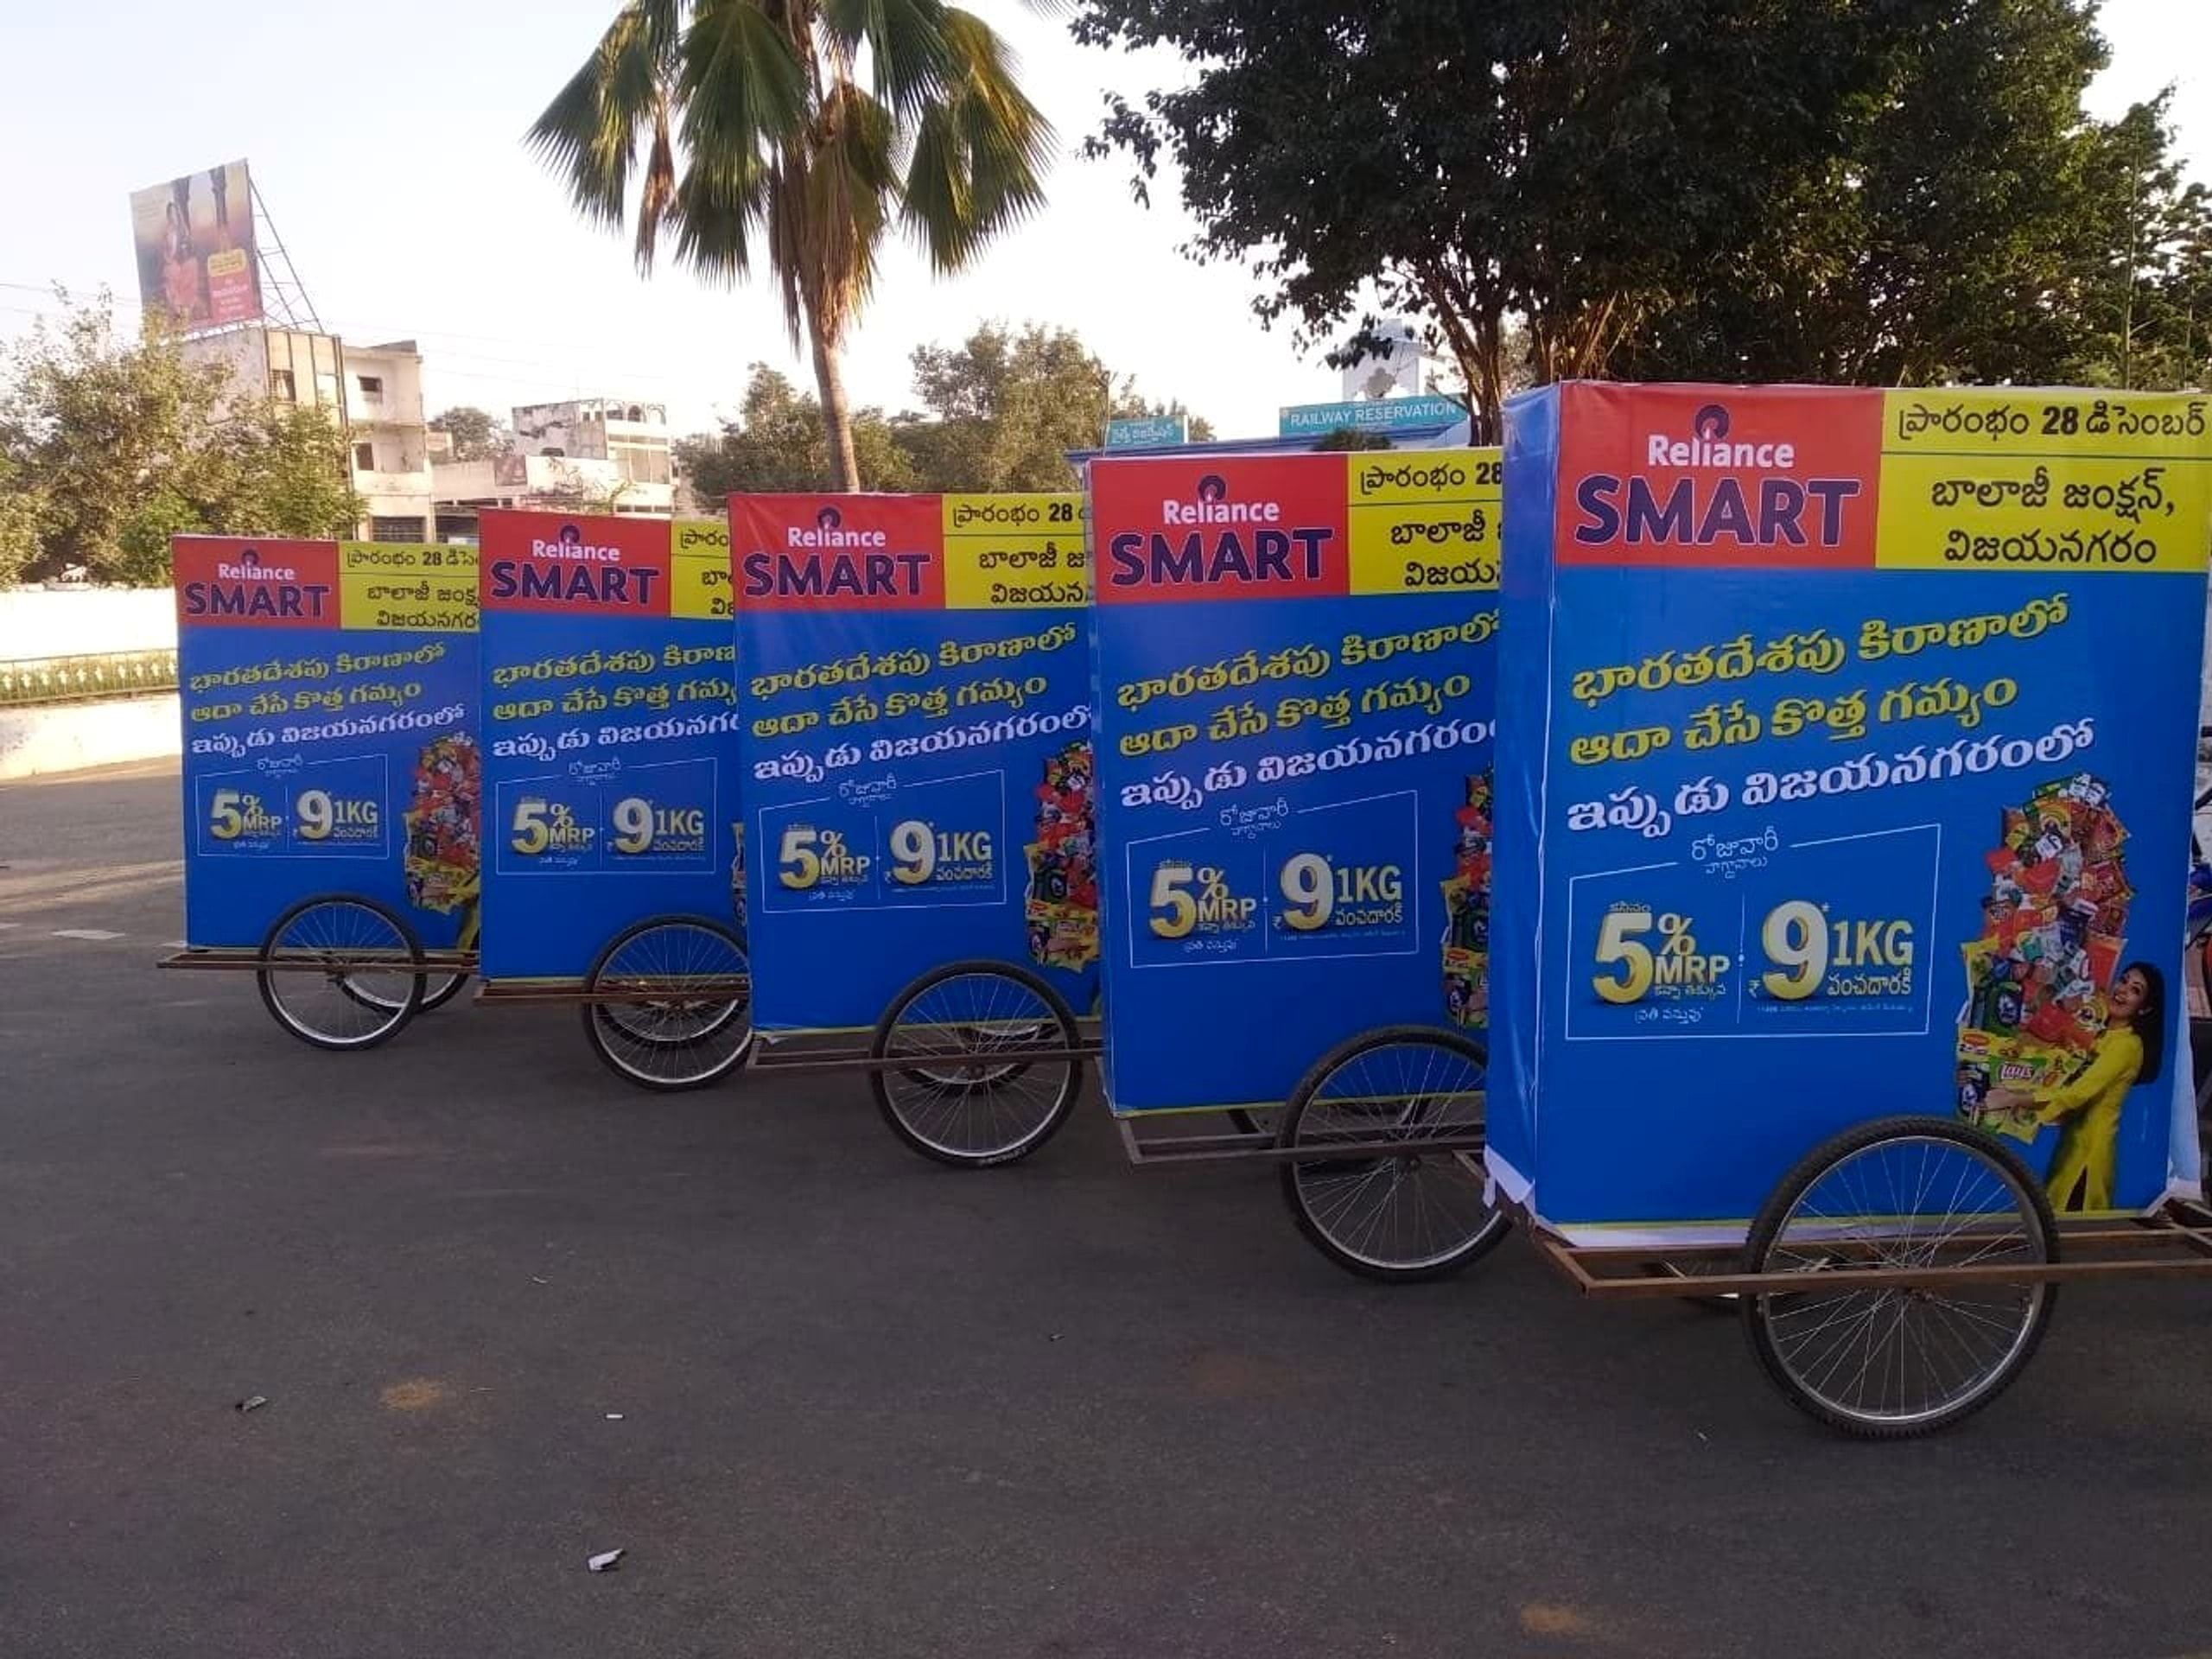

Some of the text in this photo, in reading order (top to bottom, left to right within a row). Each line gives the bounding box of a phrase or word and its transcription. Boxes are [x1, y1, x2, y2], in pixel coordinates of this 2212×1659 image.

[1291, 401, 1457, 427] RAILWAY RESERVATION
[1898, 400, 2208, 442] ప్రారంభం 28 డిసెంబర్
[1648, 431, 1795, 469] Reliance
[1361, 466, 1465, 495] ప్రారంభం
[1931, 466, 2176, 524] బాలాజీ జంక్షన్,
[953, 503, 1073, 528] ప్రారంభం 28
[1163, 496, 1280, 524] Reliance
[1390, 509, 1485, 545] బాలాజీ
[1573, 474, 1861, 548] SMART
[532, 537, 621, 562] Reliance
[787, 524, 887, 548] Reliance
[1943, 529, 2158, 565] విజయనగరం
[219, 562, 296, 581] Reliance
[423, 551, 442, 566] 28
[978, 542, 1057, 569] బాలాజీ
[1109, 527, 1334, 587] SMART
[367, 580, 430, 601] బాలాజీ
[491, 561, 659, 604] SMART
[742, 552, 931, 597] SMART
[184, 582, 330, 617] SMART
[750, 622, 1077, 700] భారతదేశపు కిరాణాలో
[1570, 592, 2071, 709] భారతదేశపు కిరాణాలో
[190, 658, 330, 693] భారతదేశపు
[492, 650, 656, 689] భారతదేశపు
[1117, 644, 1332, 711] భారతదేశపు
[191, 702, 243, 721] ఆదా
[249, 694, 289, 716] చేసే
[493, 699, 554, 720] ఆదా
[563, 686, 608, 713] చేసే
[613, 683, 671, 709] కొత్త
[752, 675, 1048, 739] ఆదా చేసే కొత్త గమ్యం
[1119, 671, 1471, 757] ఆదా చేసే కొత్త గమ్యం
[281, 703, 466, 744] విజయనగరంలో
[1568, 676, 2018, 766] ఆదా చేసే కొత్త గమ్యం
[753, 744, 862, 784] ఇప్పుడు
[1120, 718, 1496, 810] ఇప్పుడు విజయనగరం
[1567, 717, 2097, 840] ఇప్పుడు విజయనగరంలో
[242, 815, 282, 830] MRP
[550, 828, 595, 843] MRP
[822, 857, 871, 875] MRP
[1198, 899, 1257, 922] MRP
[1654, 954, 1732, 985] MRP
